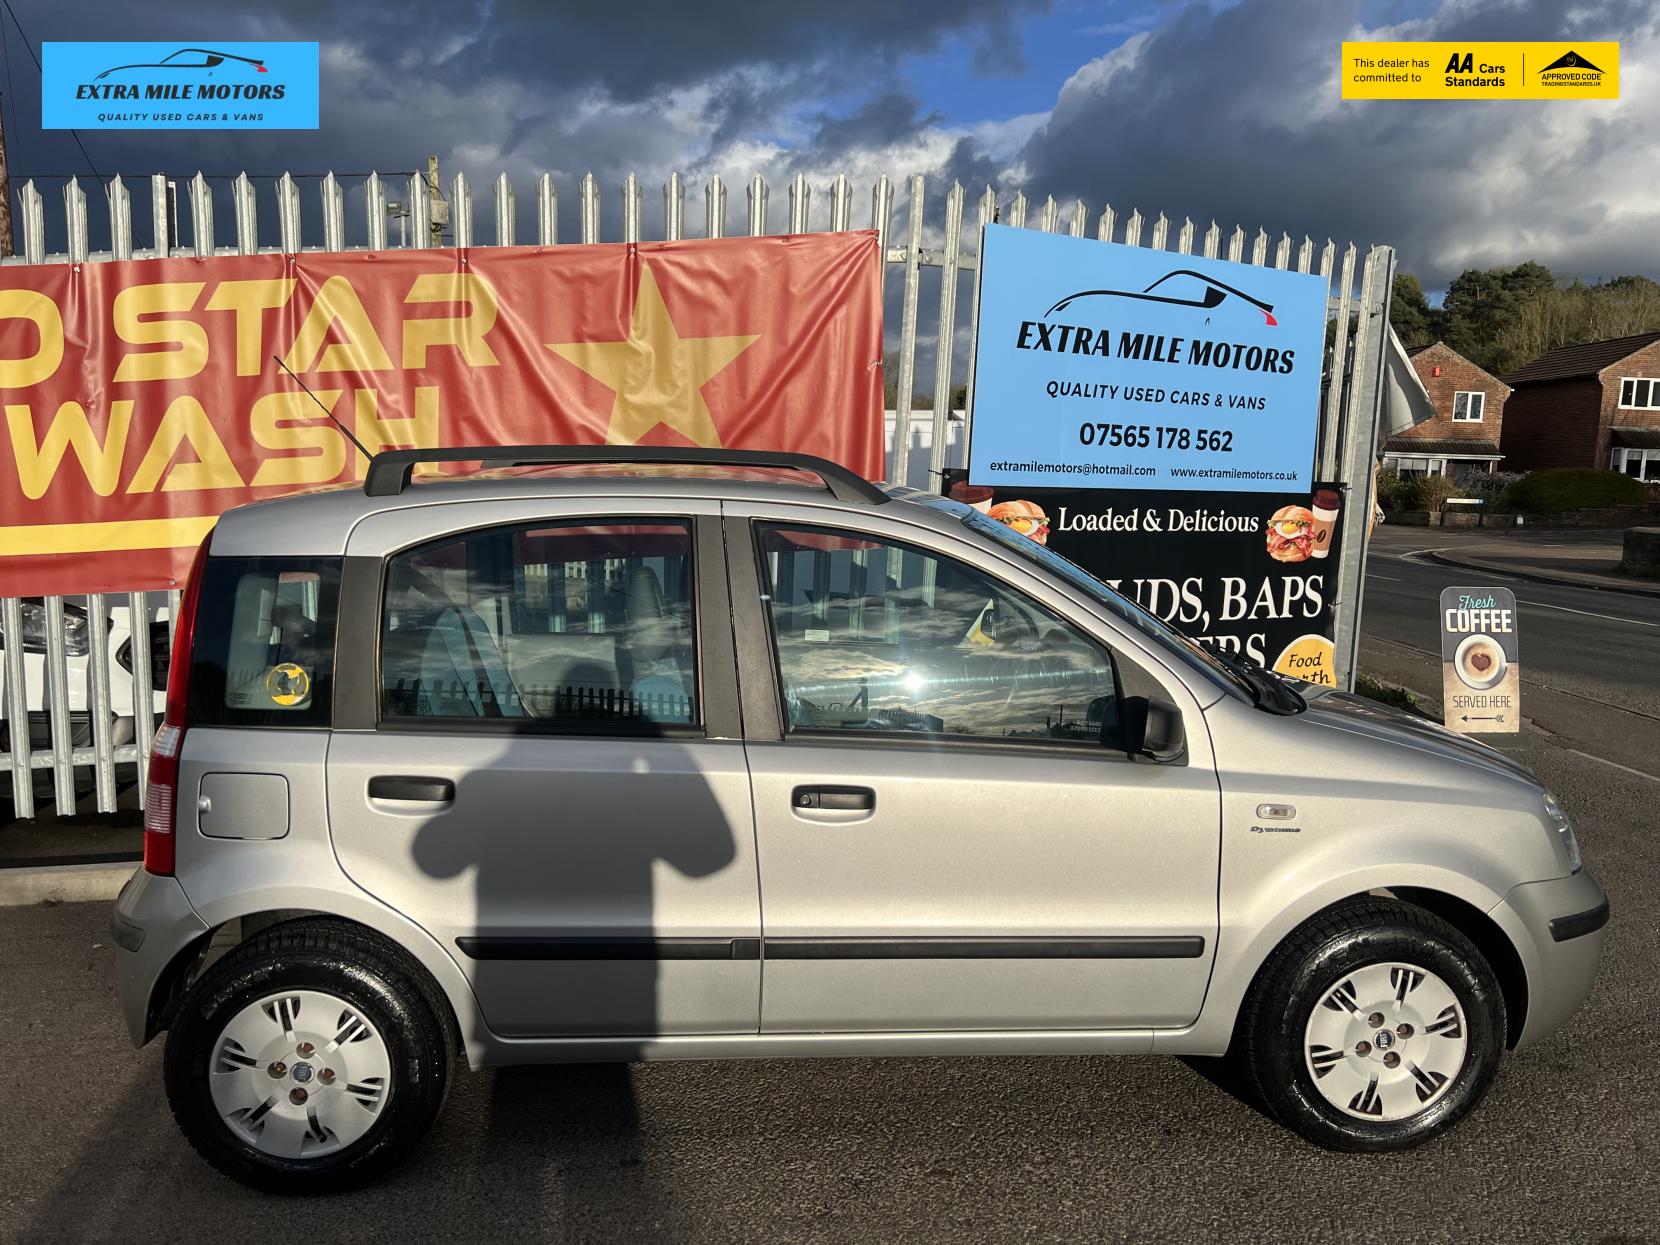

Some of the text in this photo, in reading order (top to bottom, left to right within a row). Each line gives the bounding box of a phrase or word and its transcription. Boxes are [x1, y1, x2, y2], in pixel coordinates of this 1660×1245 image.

[113, 273, 500, 382] STAR
[1016, 320, 1295, 375] EXTRA MILE MOTORS
[1046, 380, 1266, 411] QUALITY USED CARS & VANS
[4, 386, 440, 499] WASH
[1079, 422, 1233, 452] 07565 178 562
[989, 460, 1156, 476] extramilemotors@hotmail.com
[1170, 467, 1298, 481] www.extramilemotors.co.uk
[1057, 506, 1259, 533] Loaded & Delicious
[1218, 574, 1324, 621] BAPS
[1459, 595, 1496, 611] Fresh
[1446, 609, 1512, 633] COFFEE
[1288, 651, 1323, 668] Food
[1452, 695, 1512, 708] SERVED HERE
